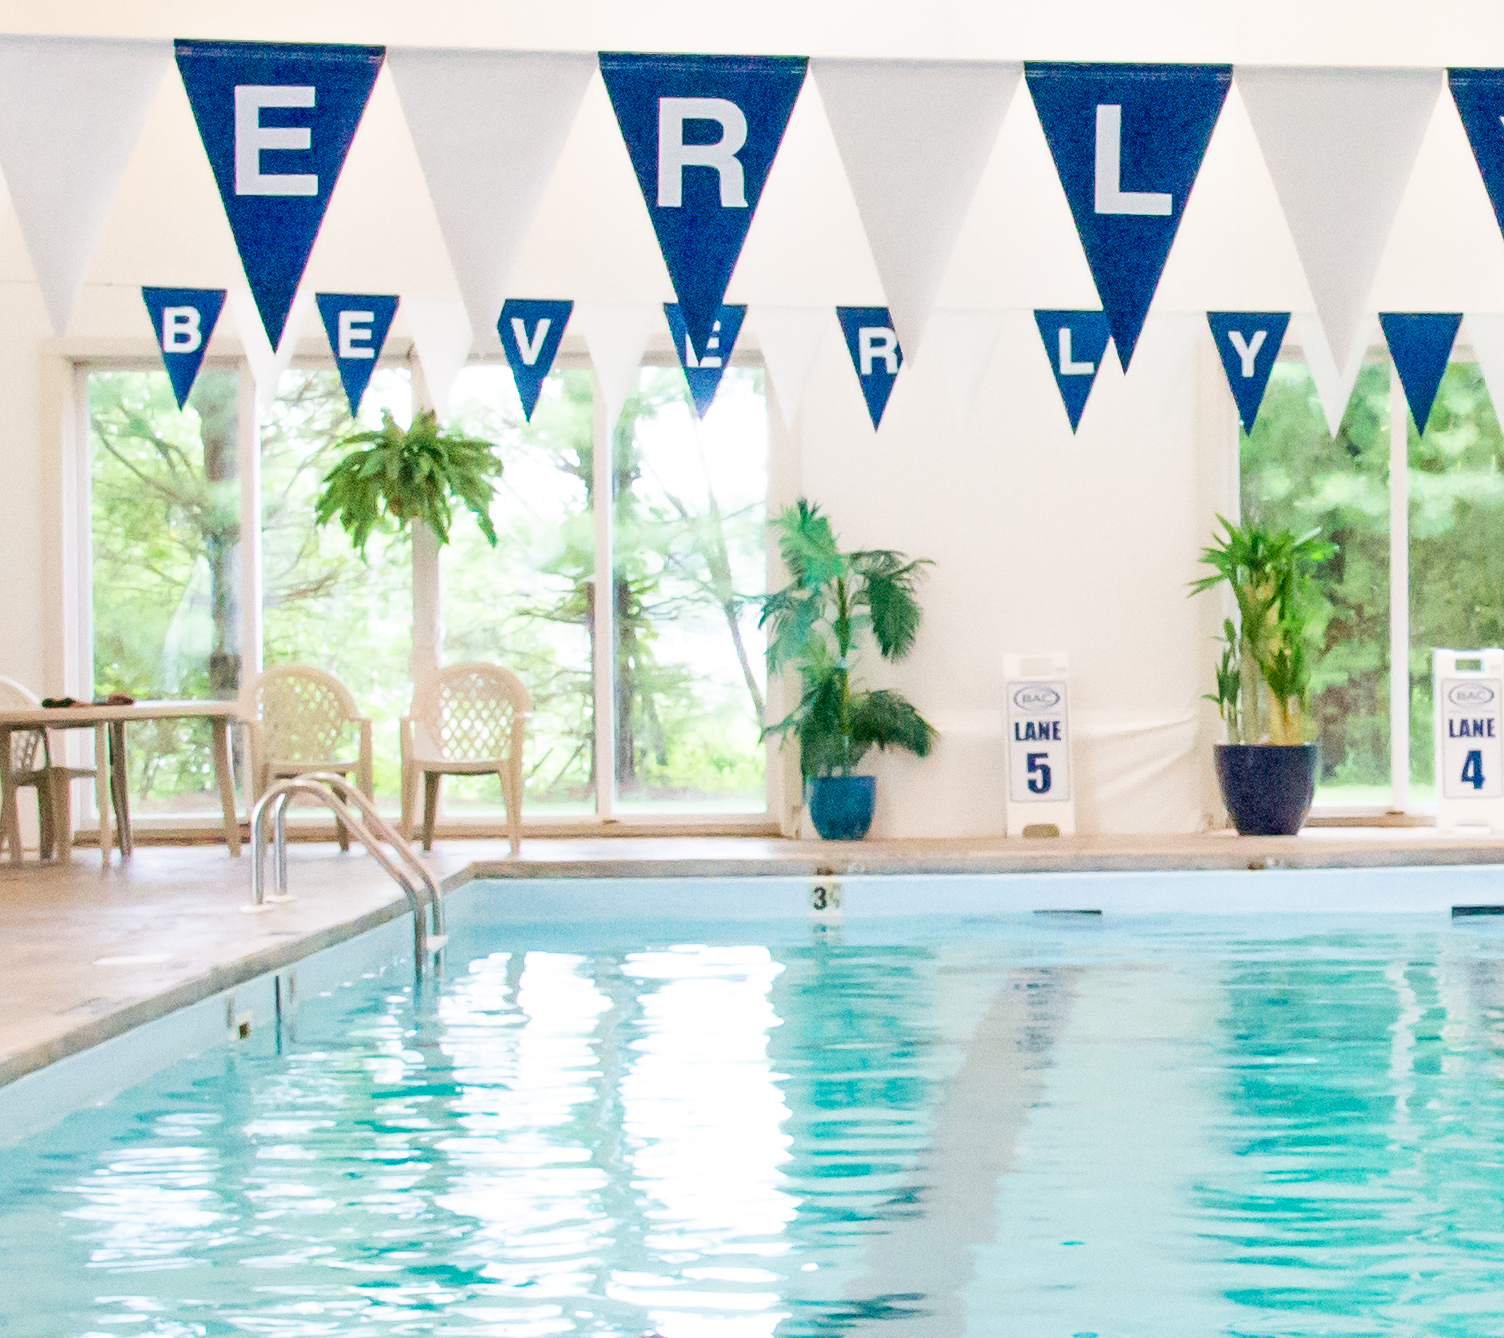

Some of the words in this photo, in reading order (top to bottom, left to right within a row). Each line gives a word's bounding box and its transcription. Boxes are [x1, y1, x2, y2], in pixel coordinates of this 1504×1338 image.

[1015, 721, 1062, 741] LANE
[1449, 718, 1496, 738] LANE
[1027, 752, 1052, 794] 5
[1461, 749, 1485, 790] 4
[813, 886, 827, 910] 3
